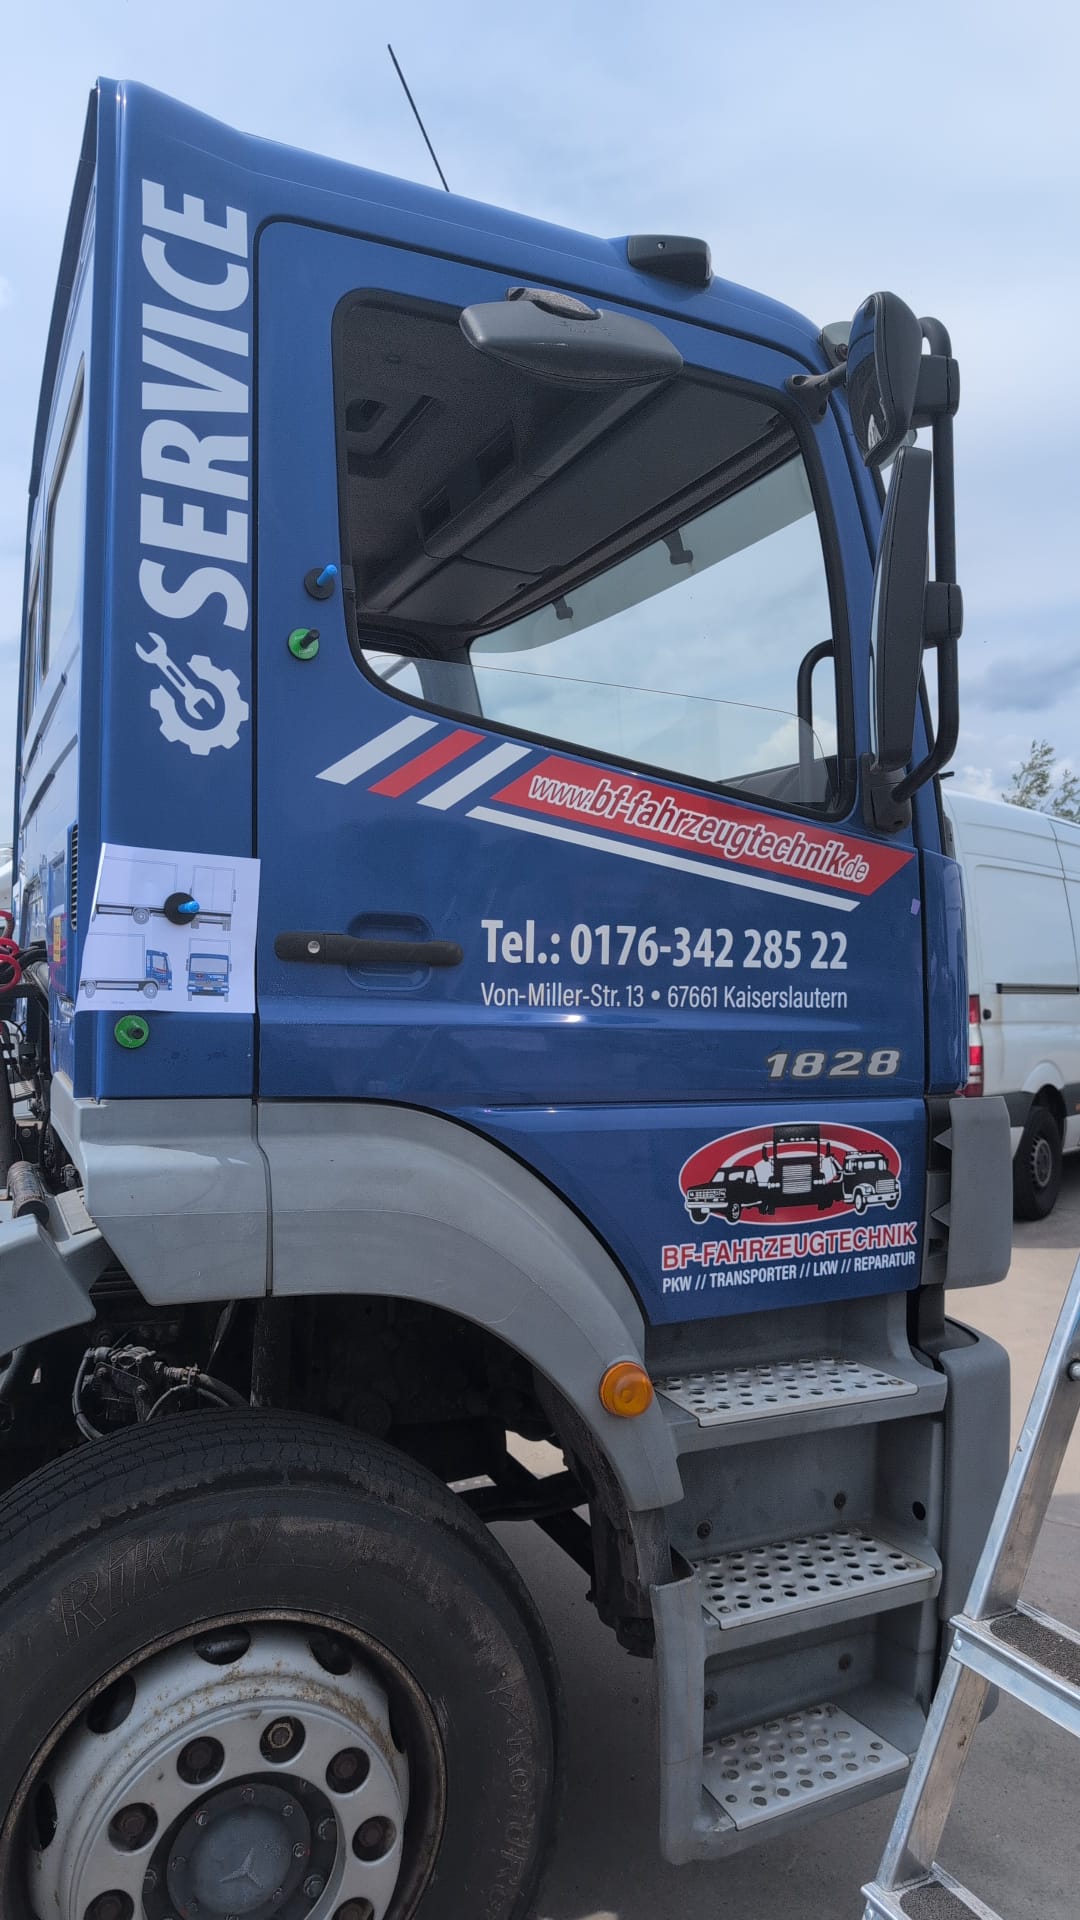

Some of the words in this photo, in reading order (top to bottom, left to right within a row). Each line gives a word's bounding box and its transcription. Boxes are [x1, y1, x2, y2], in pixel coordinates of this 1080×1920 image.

[139, 179, 250, 632] SERVICE
[528, 773, 870, 884] www.bf-fahrzeugtechnik.de
[480, 919, 561, 965] Tel.:
[570, 923, 734, 969] 0176-342
[743, 928, 802, 970] 285
[810, 930, 848, 970] 22
[480, 982, 622, 1008] Von-Miller-Str.
[625, 984, 645, 1008] 13
[667, 985, 719, 1009] 67661
[723, 984, 848, 1010] Kaiserslautern
[765, 1049, 901, 1079] 1828
[661, 1221, 918, 1271] BF-FAHRZEUGTECHNIK
[662, 1275, 693, 1294] PKW
[709, 1264, 797, 1289] TRANSPORTER
[812, 1260, 839, 1277] LKW
[853, 1250, 916, 1273] REPARATUR
